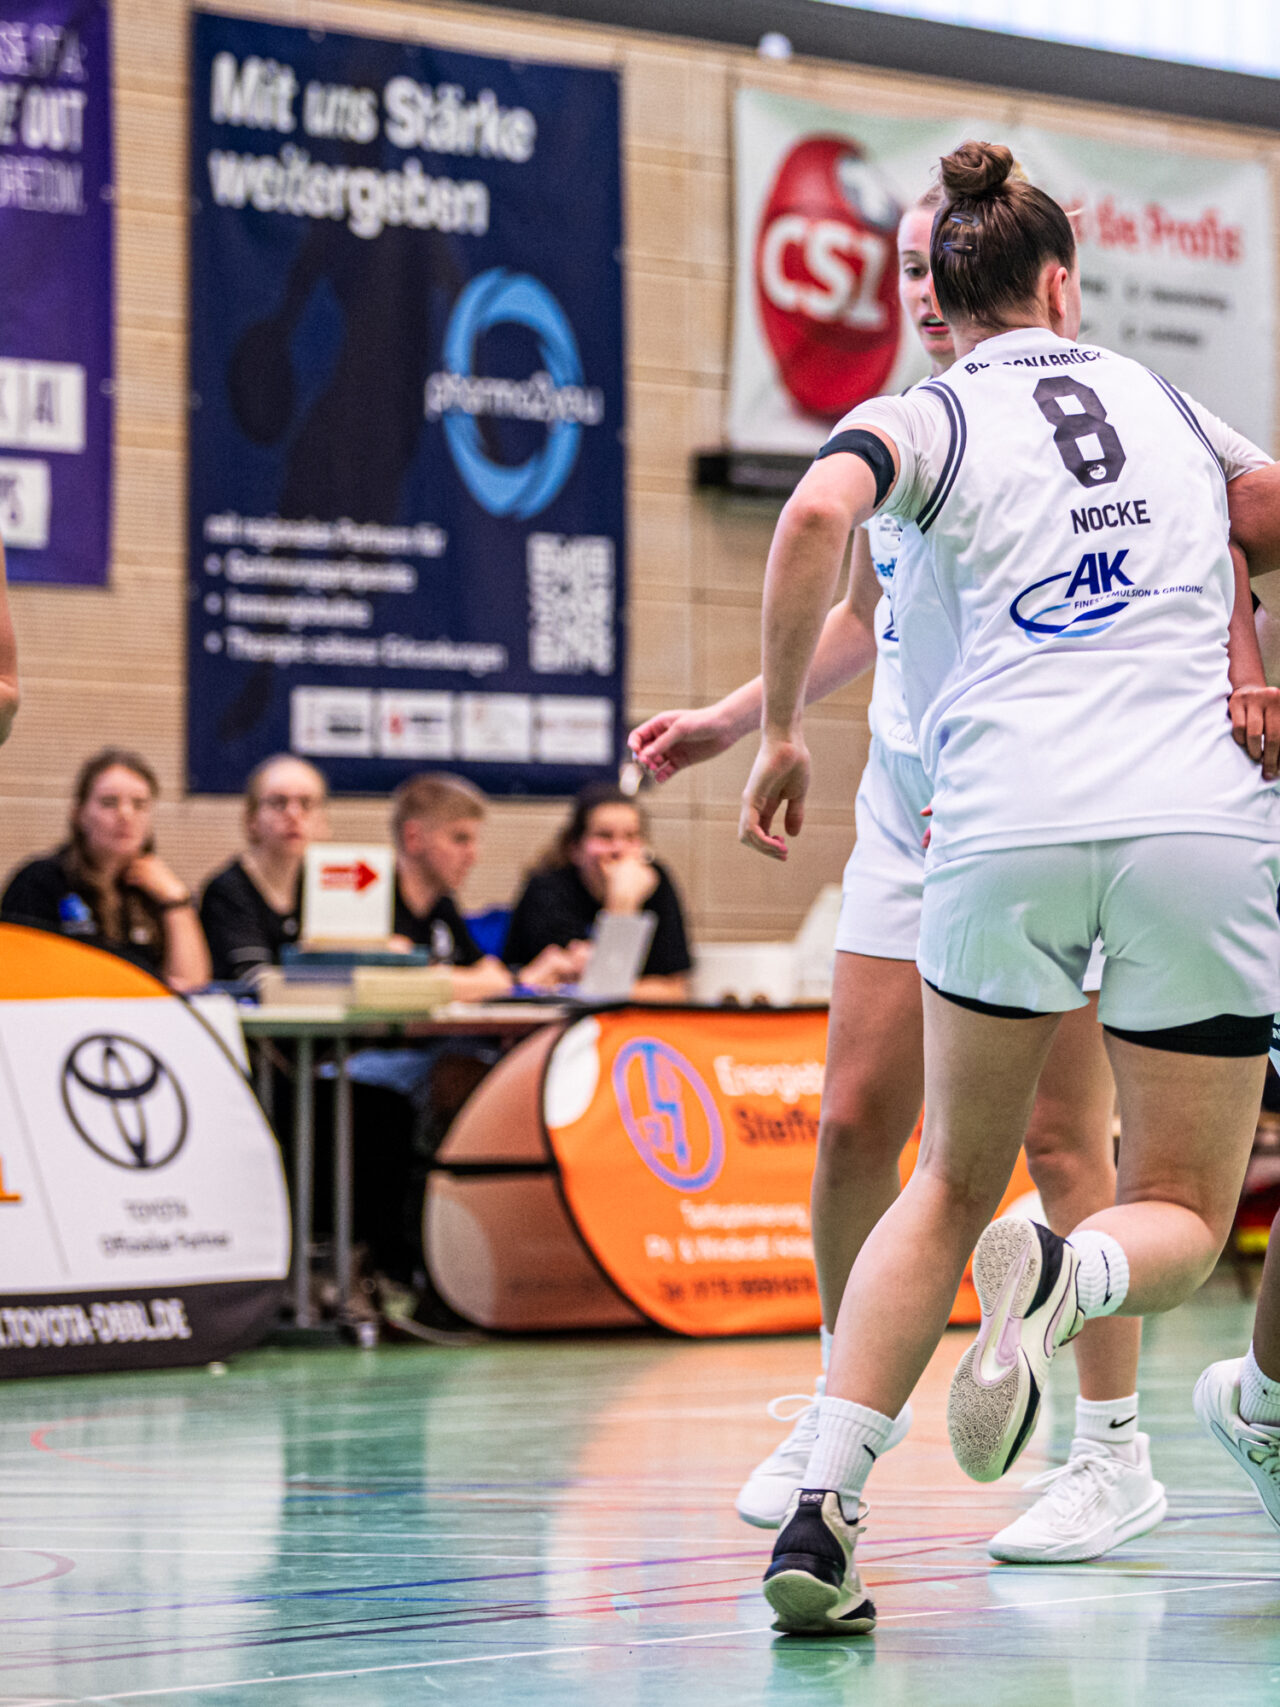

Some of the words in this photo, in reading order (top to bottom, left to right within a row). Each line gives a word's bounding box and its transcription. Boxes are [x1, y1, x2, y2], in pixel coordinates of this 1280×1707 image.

[211, 52, 298, 132] Mit
[303, 80, 379, 143] uns
[383, 76, 537, 163] Stärke
[207, 143, 490, 238] weitergeben
[1032, 375, 1127, 489] 8
[1070, 499, 1151, 534] NOCKE
[1065, 549, 1135, 599] AK
